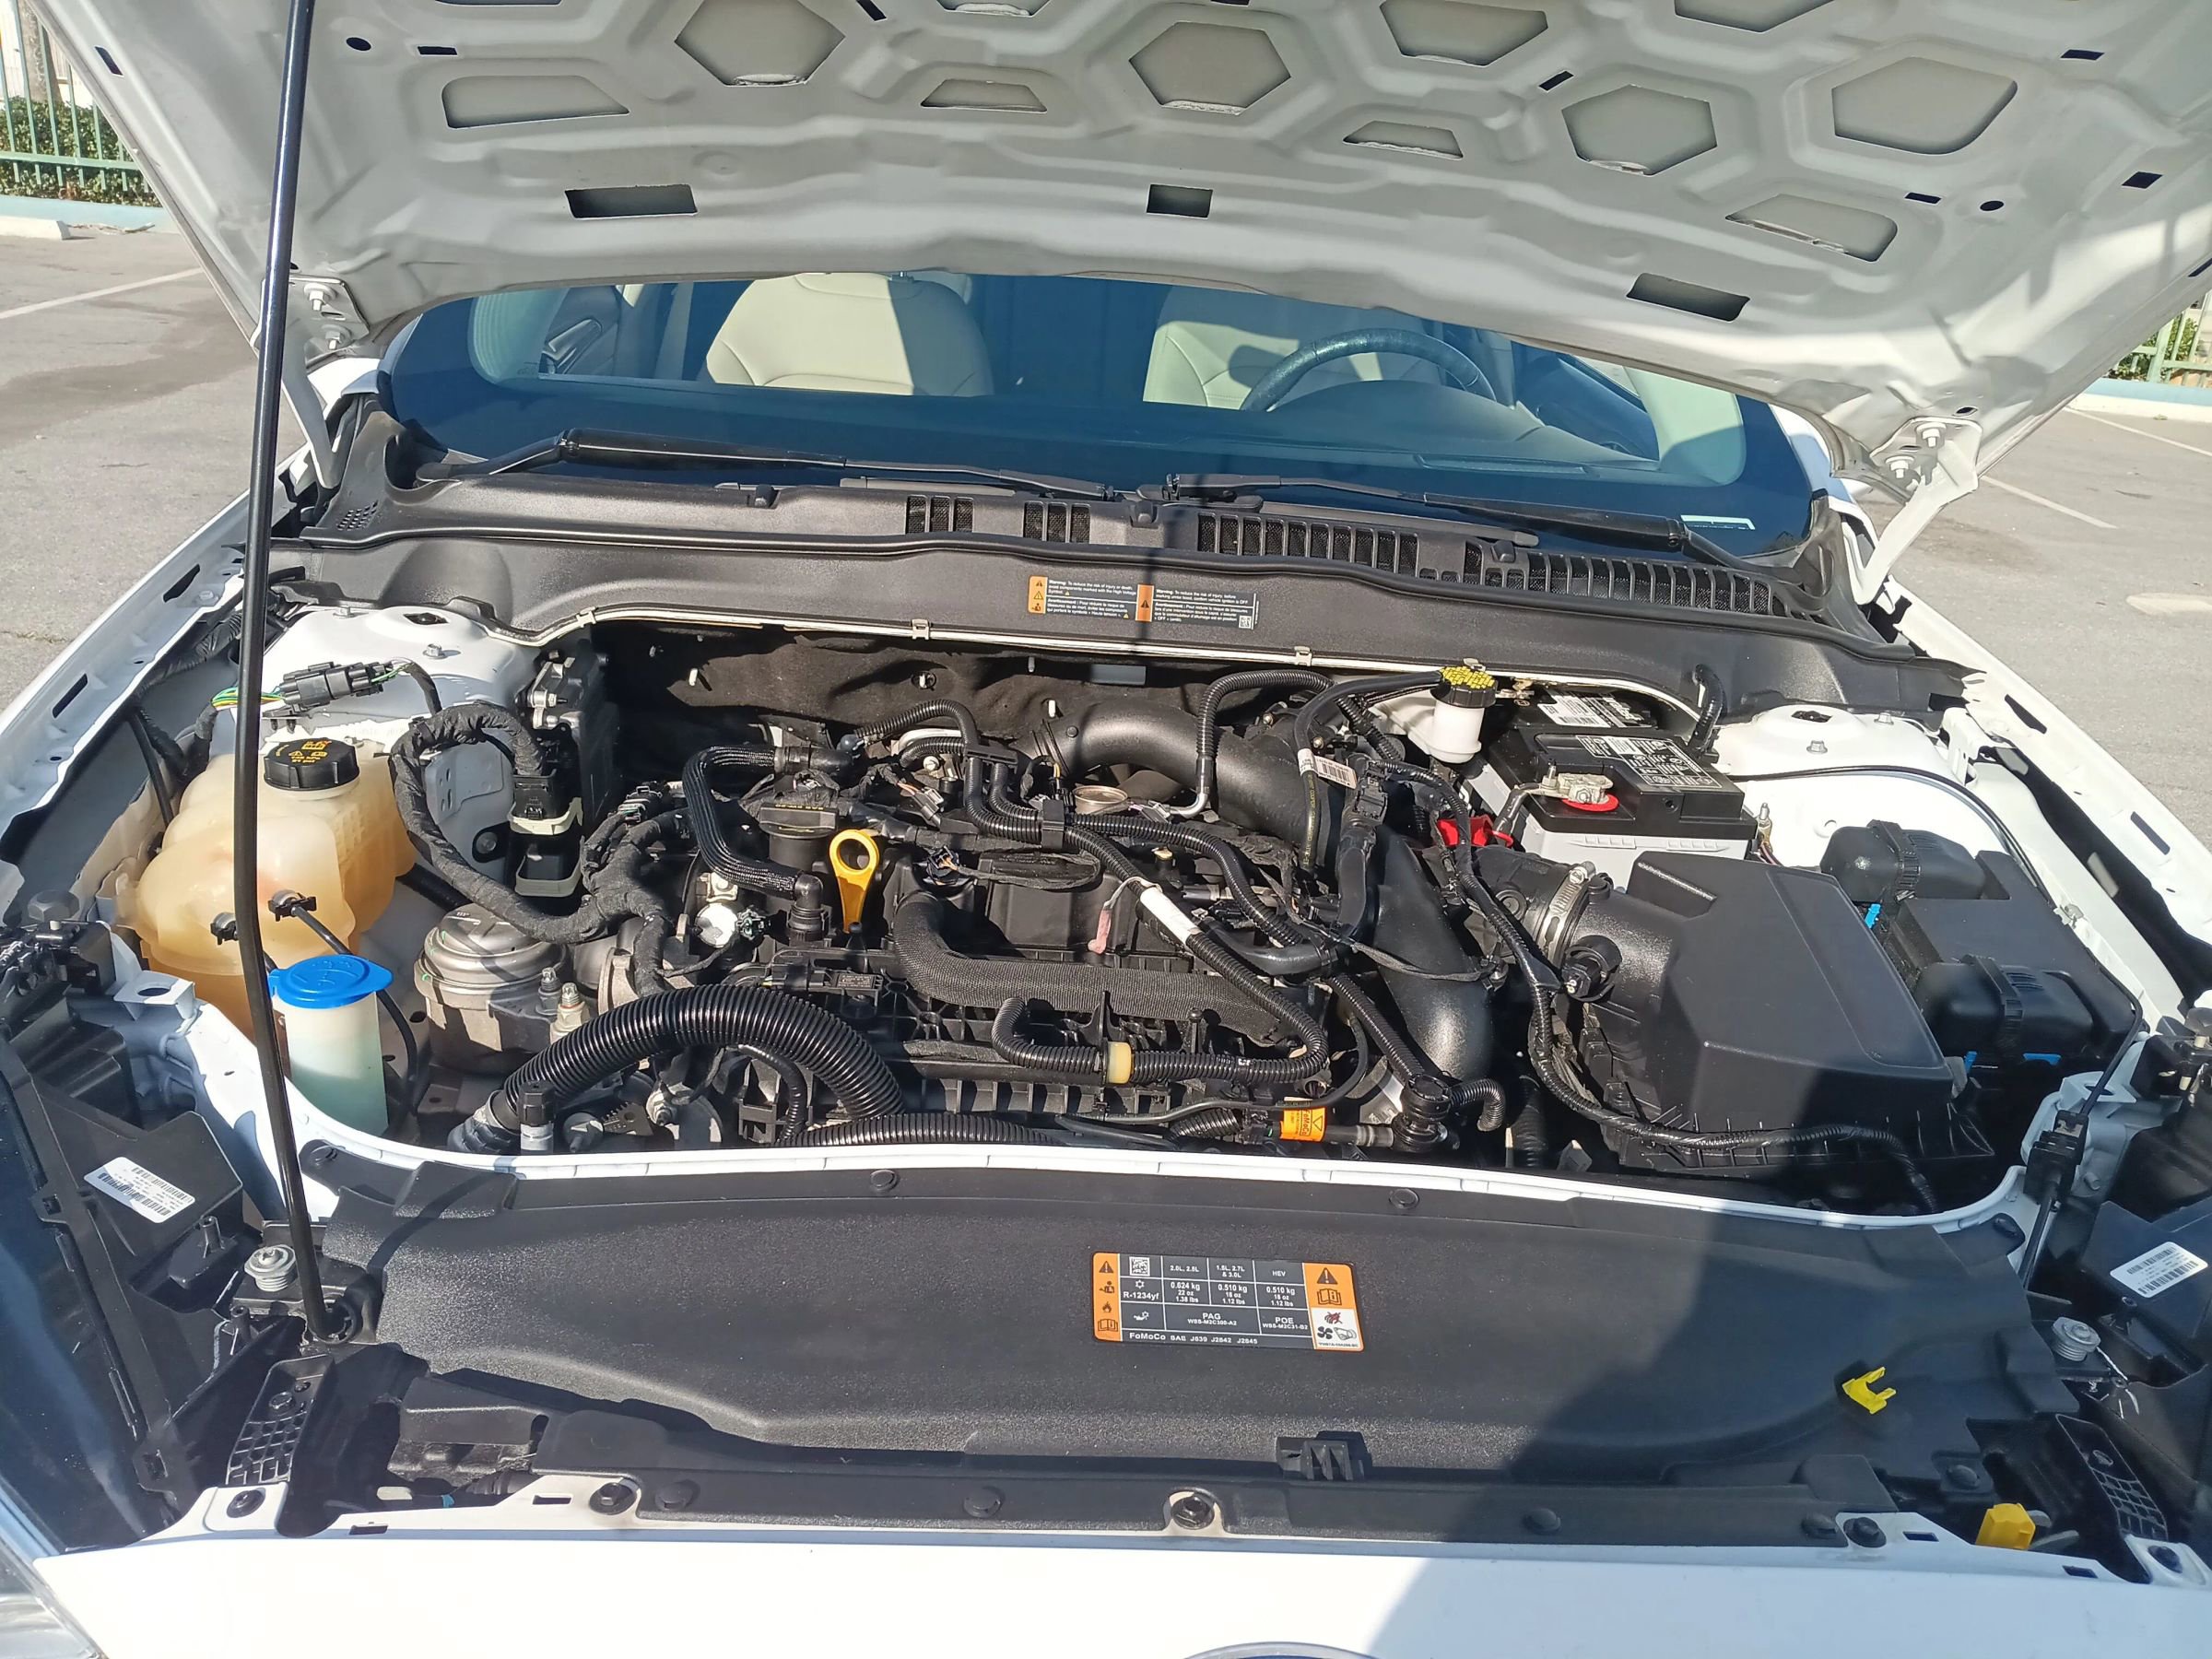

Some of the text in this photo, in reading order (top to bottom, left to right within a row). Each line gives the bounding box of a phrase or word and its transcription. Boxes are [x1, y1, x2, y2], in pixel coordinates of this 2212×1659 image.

[1301, 1110, 1310, 1135] FoMoCo
[1218, 1283, 1248, 1293] 0.510 kg
[1287, 1287, 1295, 1295] kg
[1123, 1291, 1159, 1300] R-1234yf
